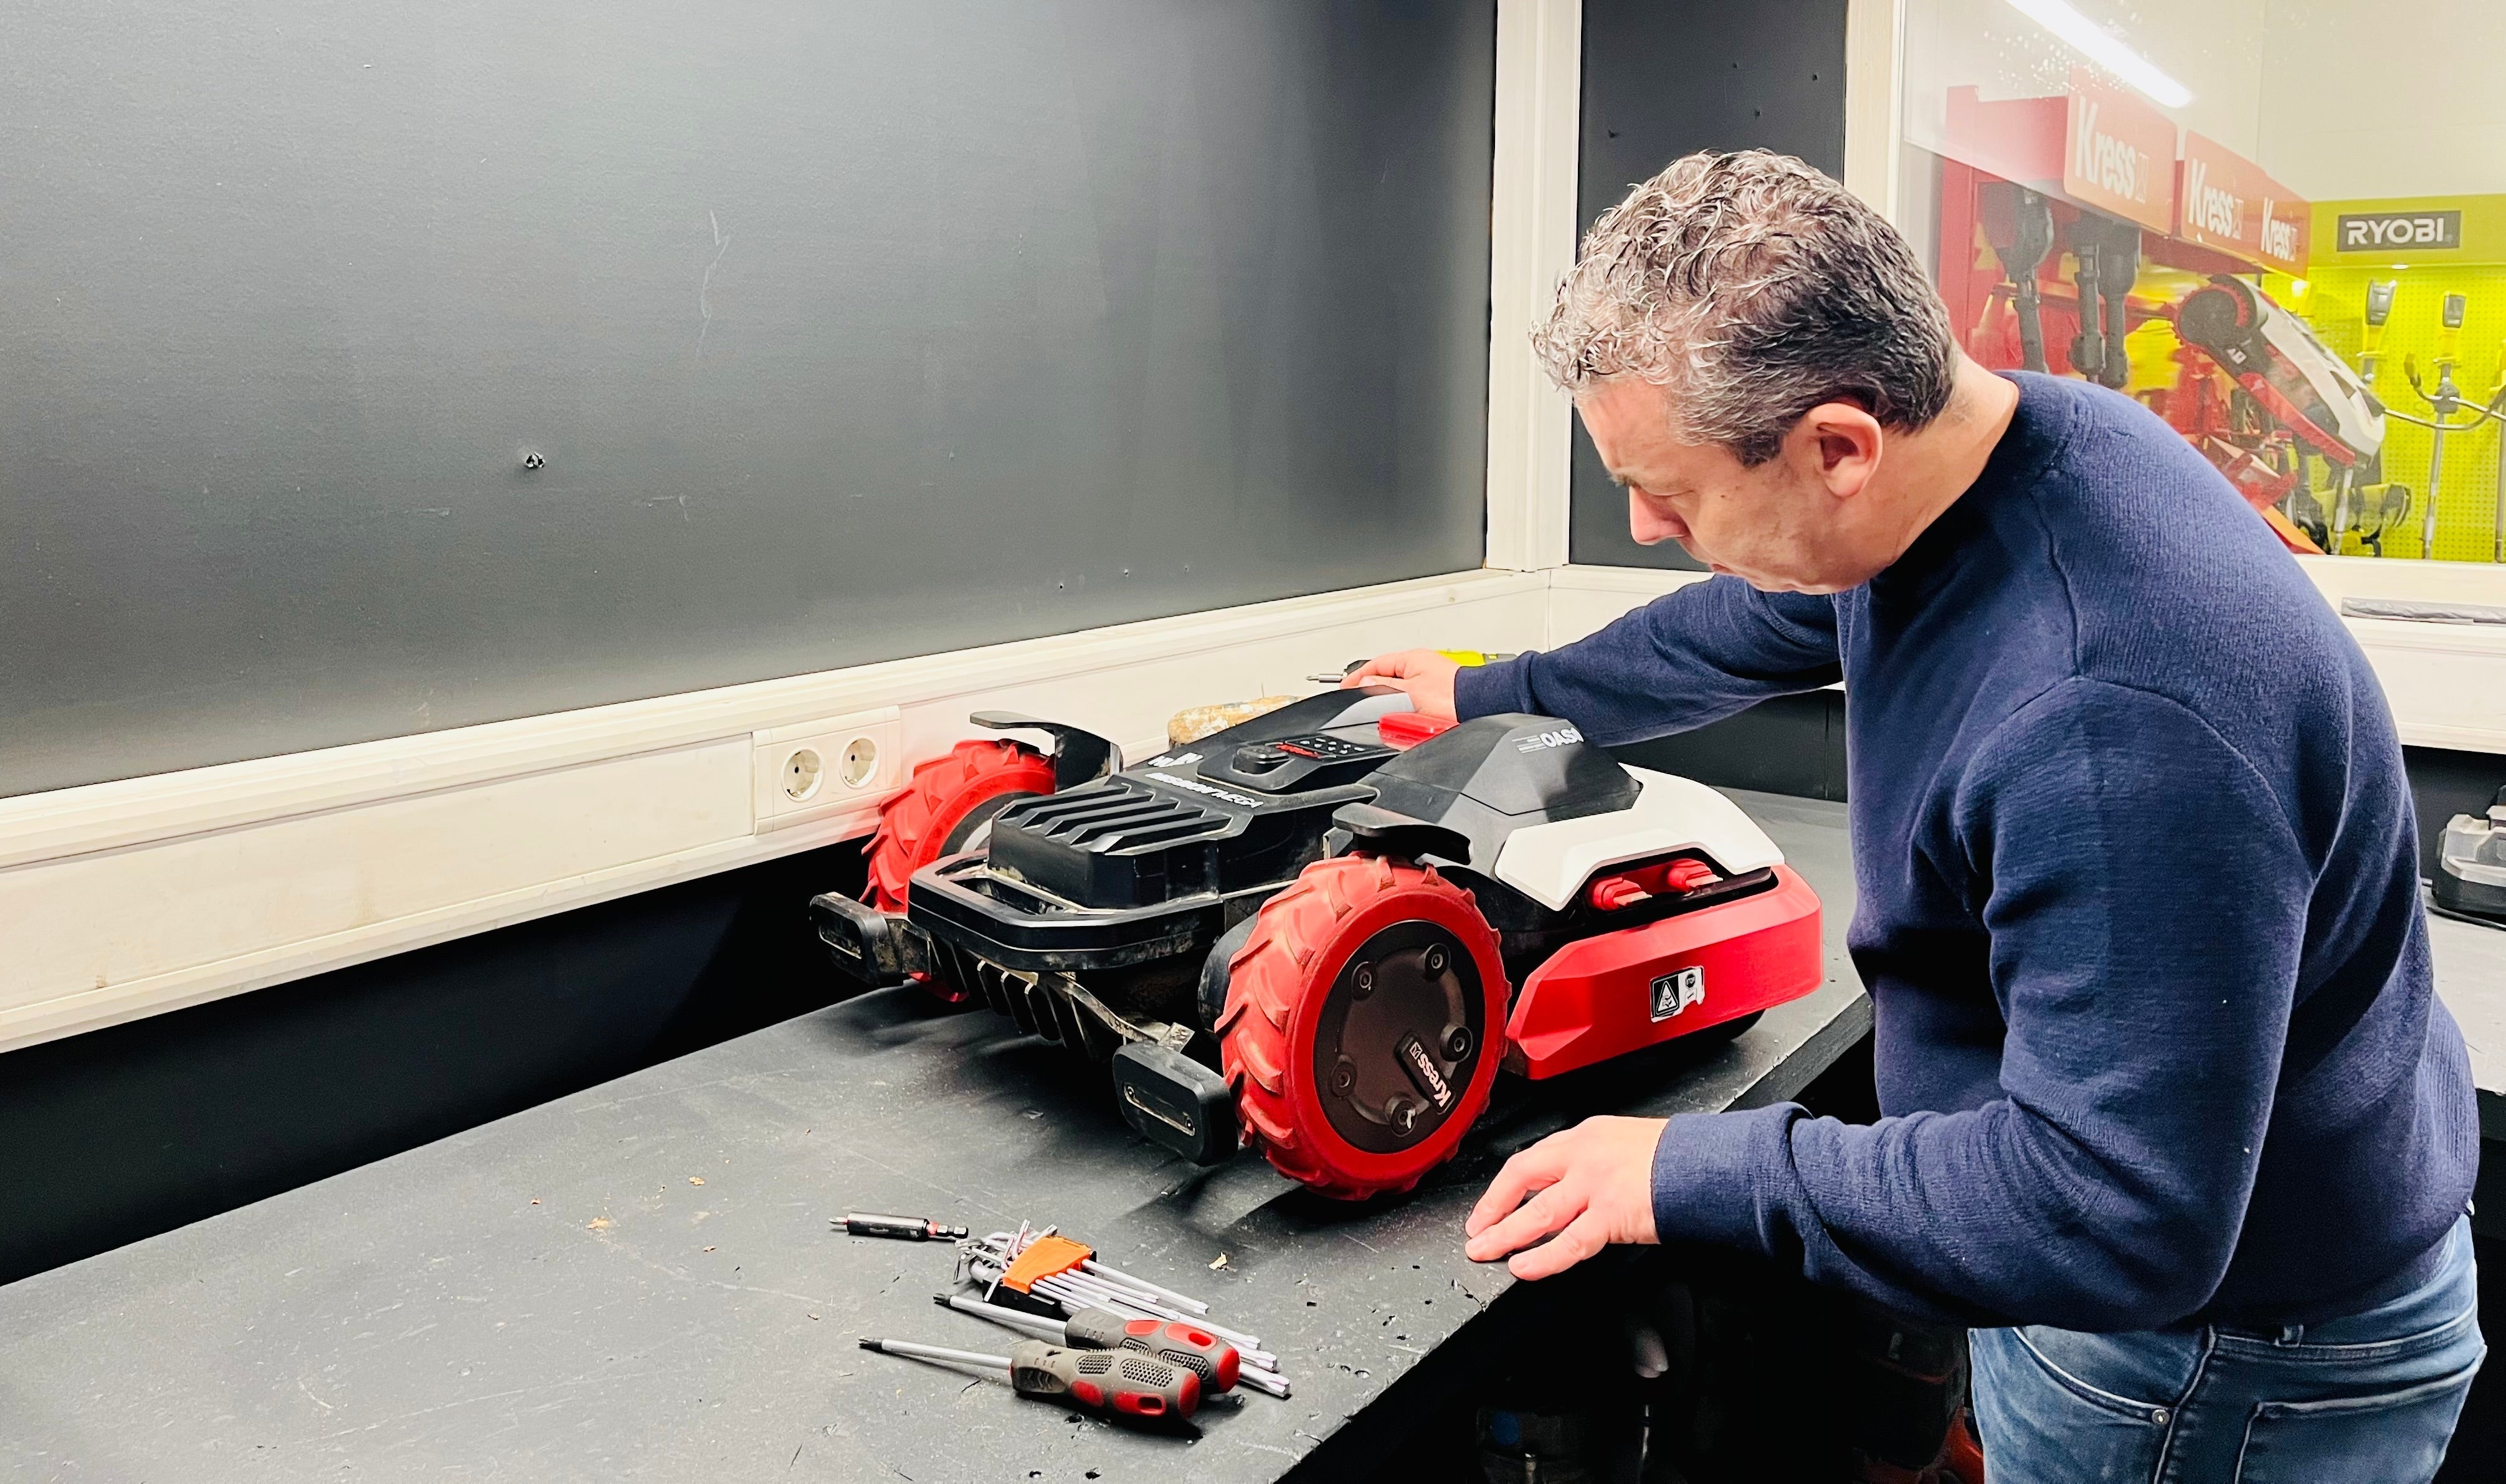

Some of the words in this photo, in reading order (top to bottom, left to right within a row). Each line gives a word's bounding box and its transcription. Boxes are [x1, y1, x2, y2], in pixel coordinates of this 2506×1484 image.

[2075, 95, 2137, 200] Kress
[2188, 158, 2234, 237] Kress
[2261, 197, 2291, 261] Kress
[2346, 218, 2444, 245] RYOBI
[1417, 1053, 1451, 1107] Kress
